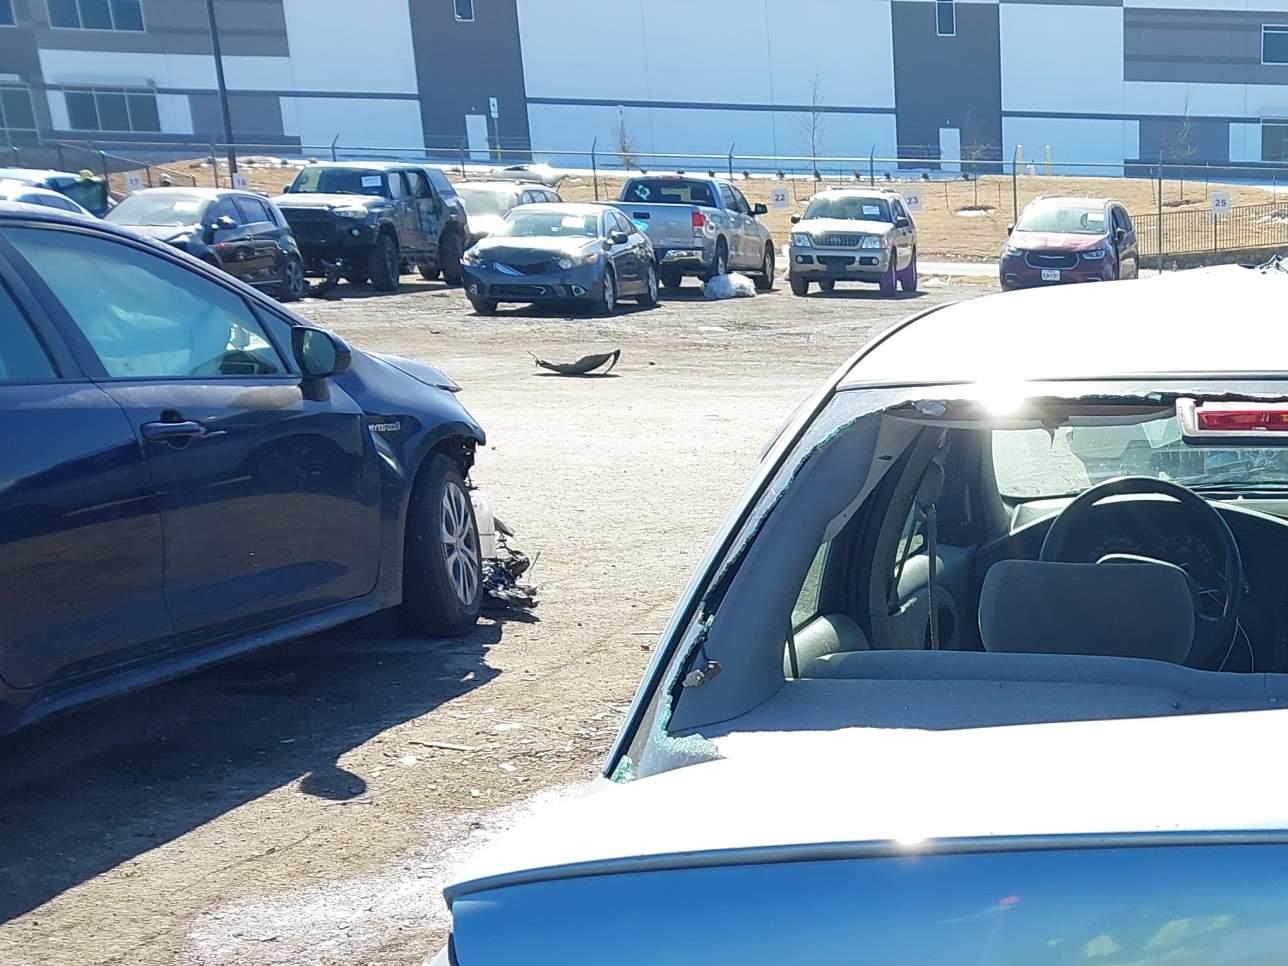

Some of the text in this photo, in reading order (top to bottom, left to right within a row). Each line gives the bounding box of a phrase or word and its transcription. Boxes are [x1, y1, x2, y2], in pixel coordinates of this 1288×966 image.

[774, 193, 785, 202] 22
[906, 195, 918, 205] 23
[1214, 198, 1227, 207] 25
